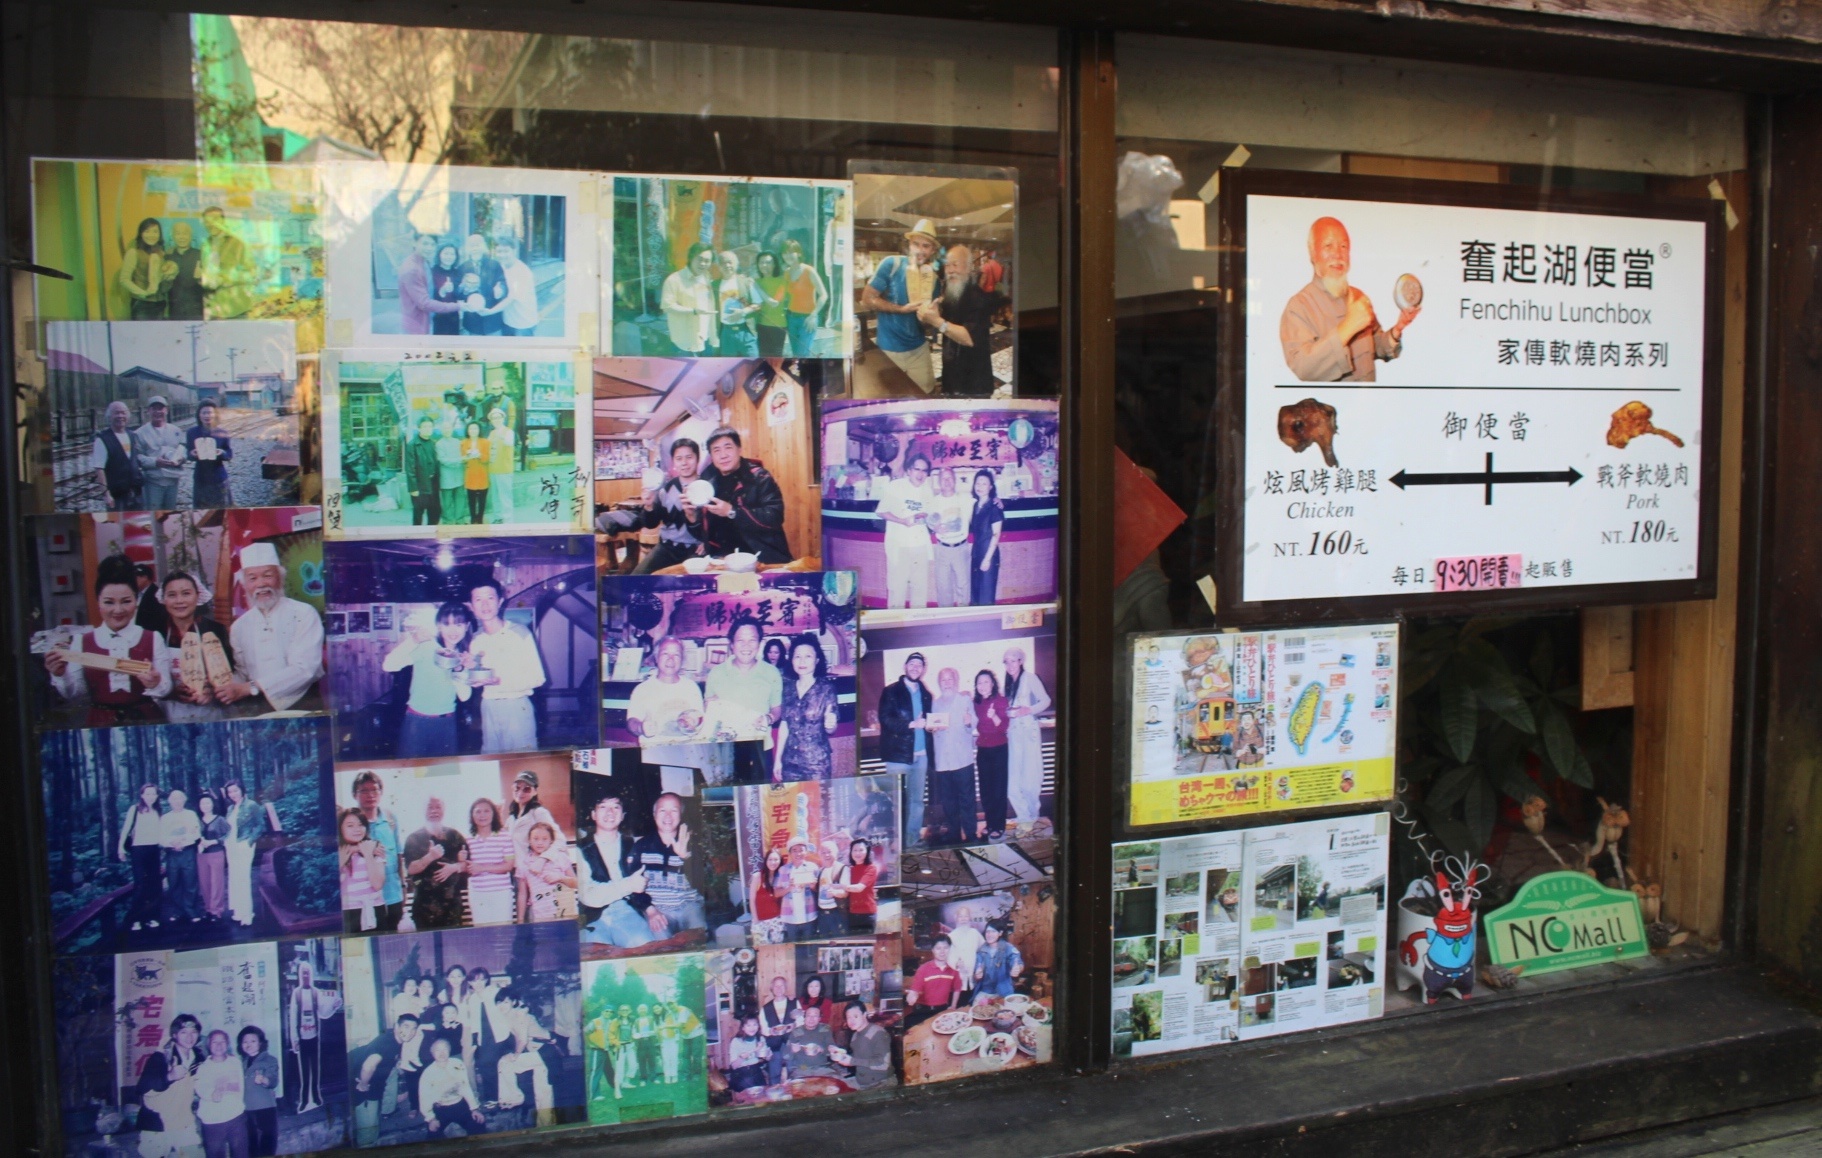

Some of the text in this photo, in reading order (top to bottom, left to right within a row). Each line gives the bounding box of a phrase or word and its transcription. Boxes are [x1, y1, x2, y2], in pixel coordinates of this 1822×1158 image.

[1460, 239, 1655, 290] 奮起湖便當
[1460, 299, 1652, 324] Fenchihu Lunchbox
[1498, 338, 1669, 367] 家傳軟燒肉系列
[1442, 411, 1531, 442] 御便當
[1264, 468, 1378, 496] 炫風烤雞腿
[1597, 463, 1689, 488] 戰斧軟燒肉
[1287, 501, 1354, 519] Chicken
[1626, 493, 1659, 509] Pork
[1274, 542, 1303, 557] NT.
[1601, 530, 1626, 544] NT.
[1392, 558, 1575, 586] 每日 起販售
[1574, 917, 1626, 949] Mall
